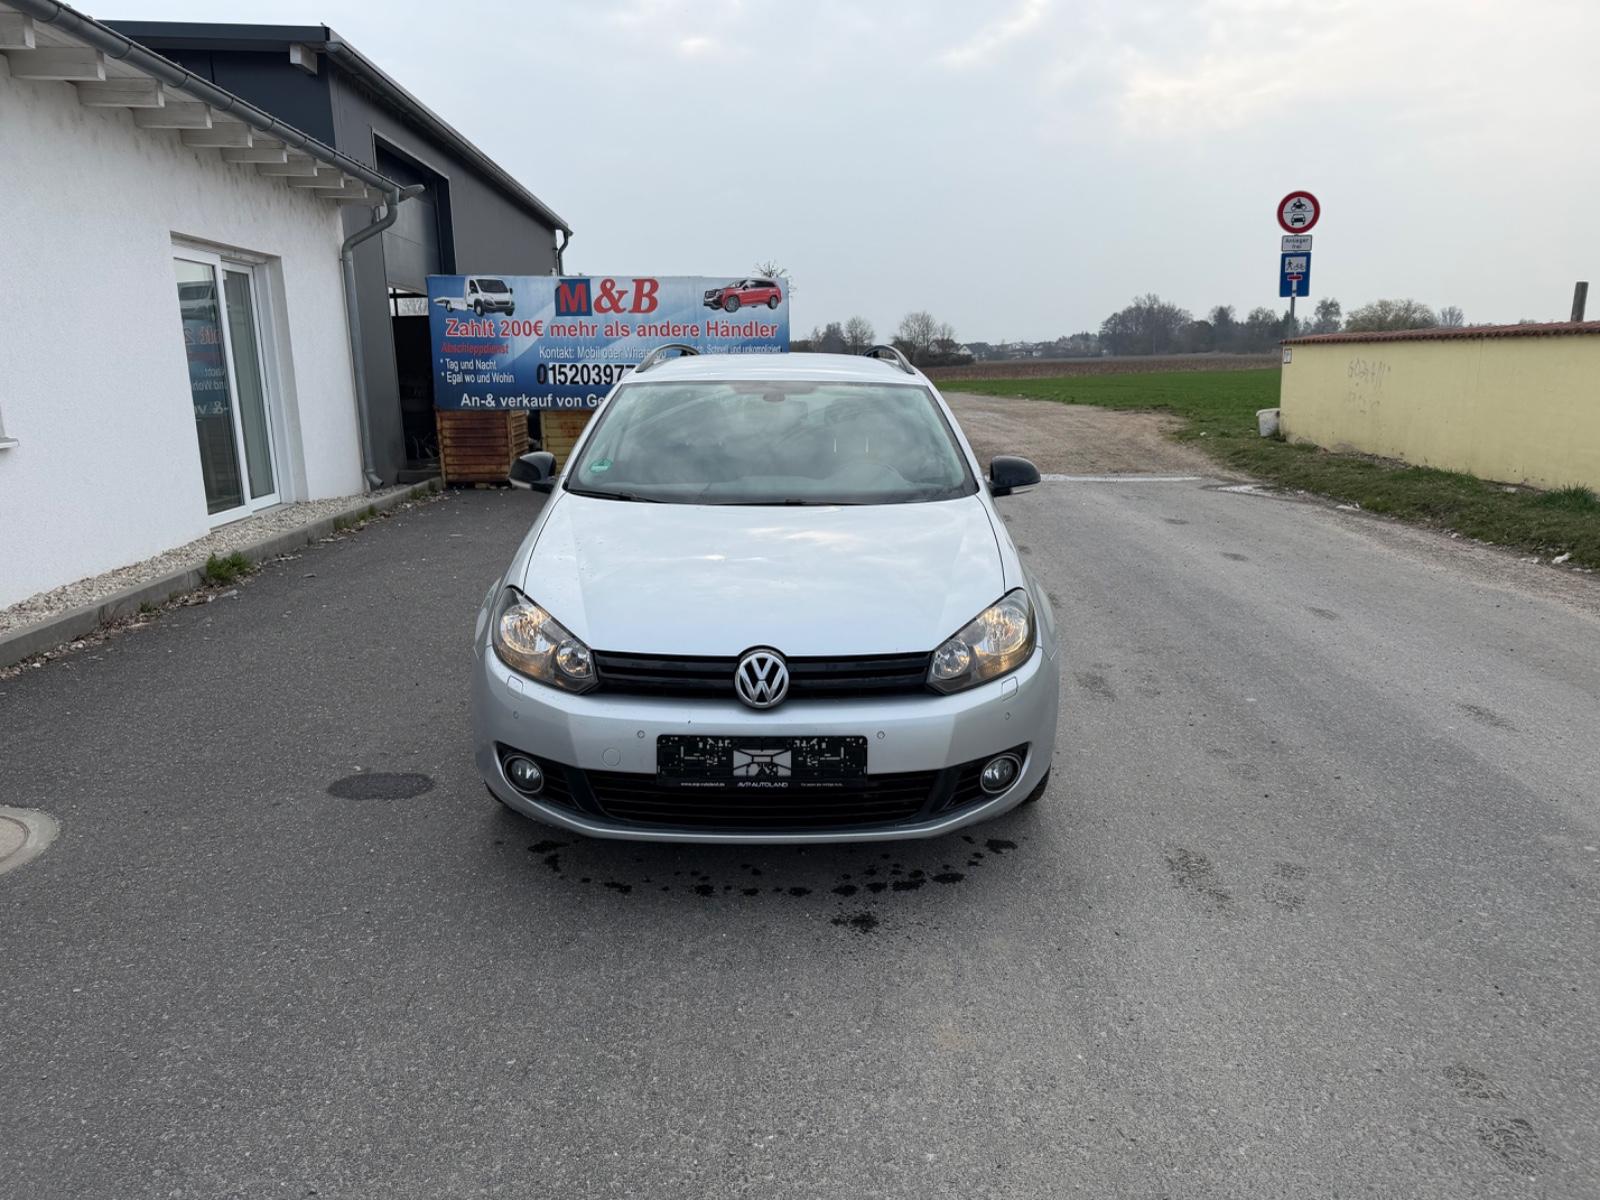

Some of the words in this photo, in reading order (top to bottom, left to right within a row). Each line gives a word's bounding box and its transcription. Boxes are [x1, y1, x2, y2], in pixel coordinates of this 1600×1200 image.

[557, 278, 659, 314] M&B
[446, 319, 496, 338] Zahlt
[499, 320, 544, 338] 200€
[550, 320, 598, 338] mehr
[604, 320, 631, 338] als
[637, 320, 700, 338] andere
[706, 320, 778, 338] Händler
[539, 346, 575, 359] Kontakt:
[577, 346, 600, 359] Mobil
[445, 358, 459, 371] Tag
[460, 359, 474, 370] und
[475, 359, 497, 370] Nacht
[446, 372, 463, 385] Egal
[465, 374, 476, 383] wo
[476, 374, 491, 383] und
[491, 372, 515, 384] Wohin
[500, 393, 553, 408] verkauf
[557, 396, 582, 408] von
